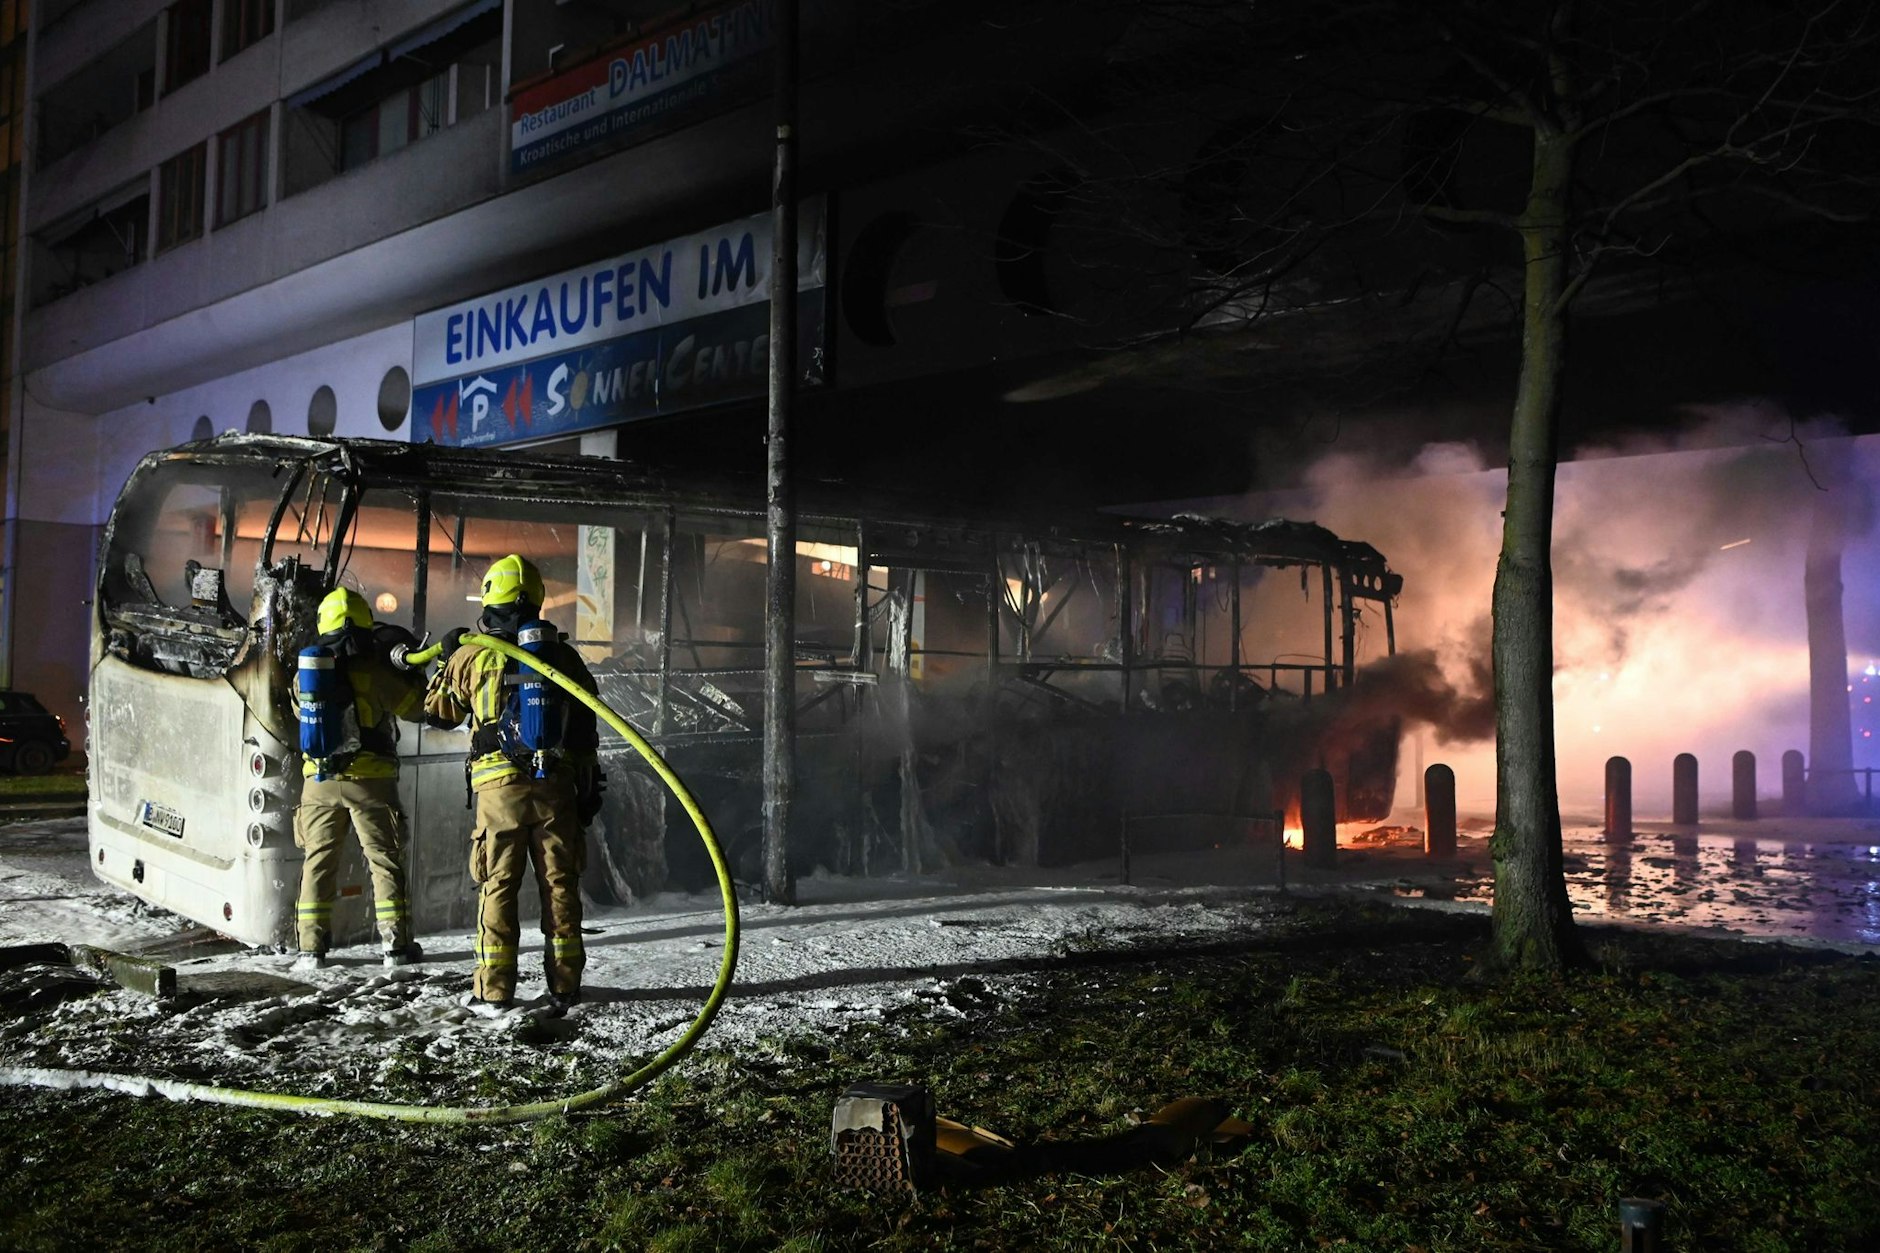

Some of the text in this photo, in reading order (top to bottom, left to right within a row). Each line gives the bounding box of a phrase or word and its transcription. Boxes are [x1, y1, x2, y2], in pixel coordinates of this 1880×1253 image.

[520, 79, 706, 165] Kroatische und Internationale
[521, 89, 596, 136] Restaurant
[447, 232, 756, 365] EINKAUFEN IM
[667, 334, 769, 390] CENTE
[527, 697, 540, 706] 300
